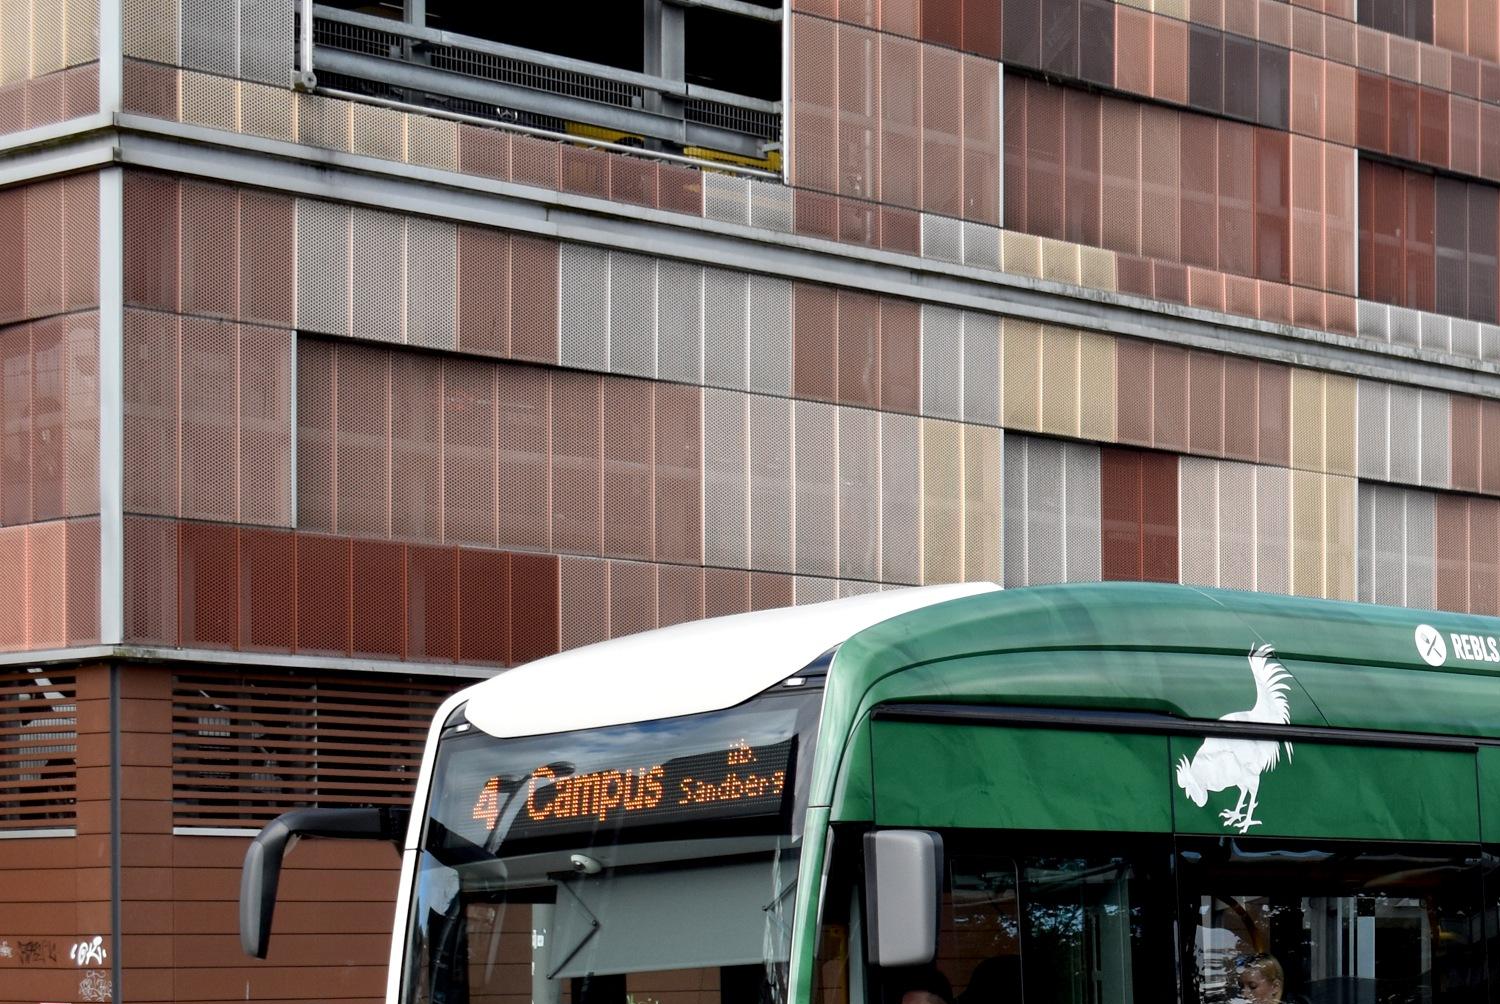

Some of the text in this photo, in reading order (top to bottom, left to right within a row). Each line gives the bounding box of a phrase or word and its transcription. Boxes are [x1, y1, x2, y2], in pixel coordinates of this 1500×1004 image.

[1450, 633, 1499, 663] REBLS
[472, 764, 666, 831] 4 Campus
[679, 771, 785, 805] Sandberg
